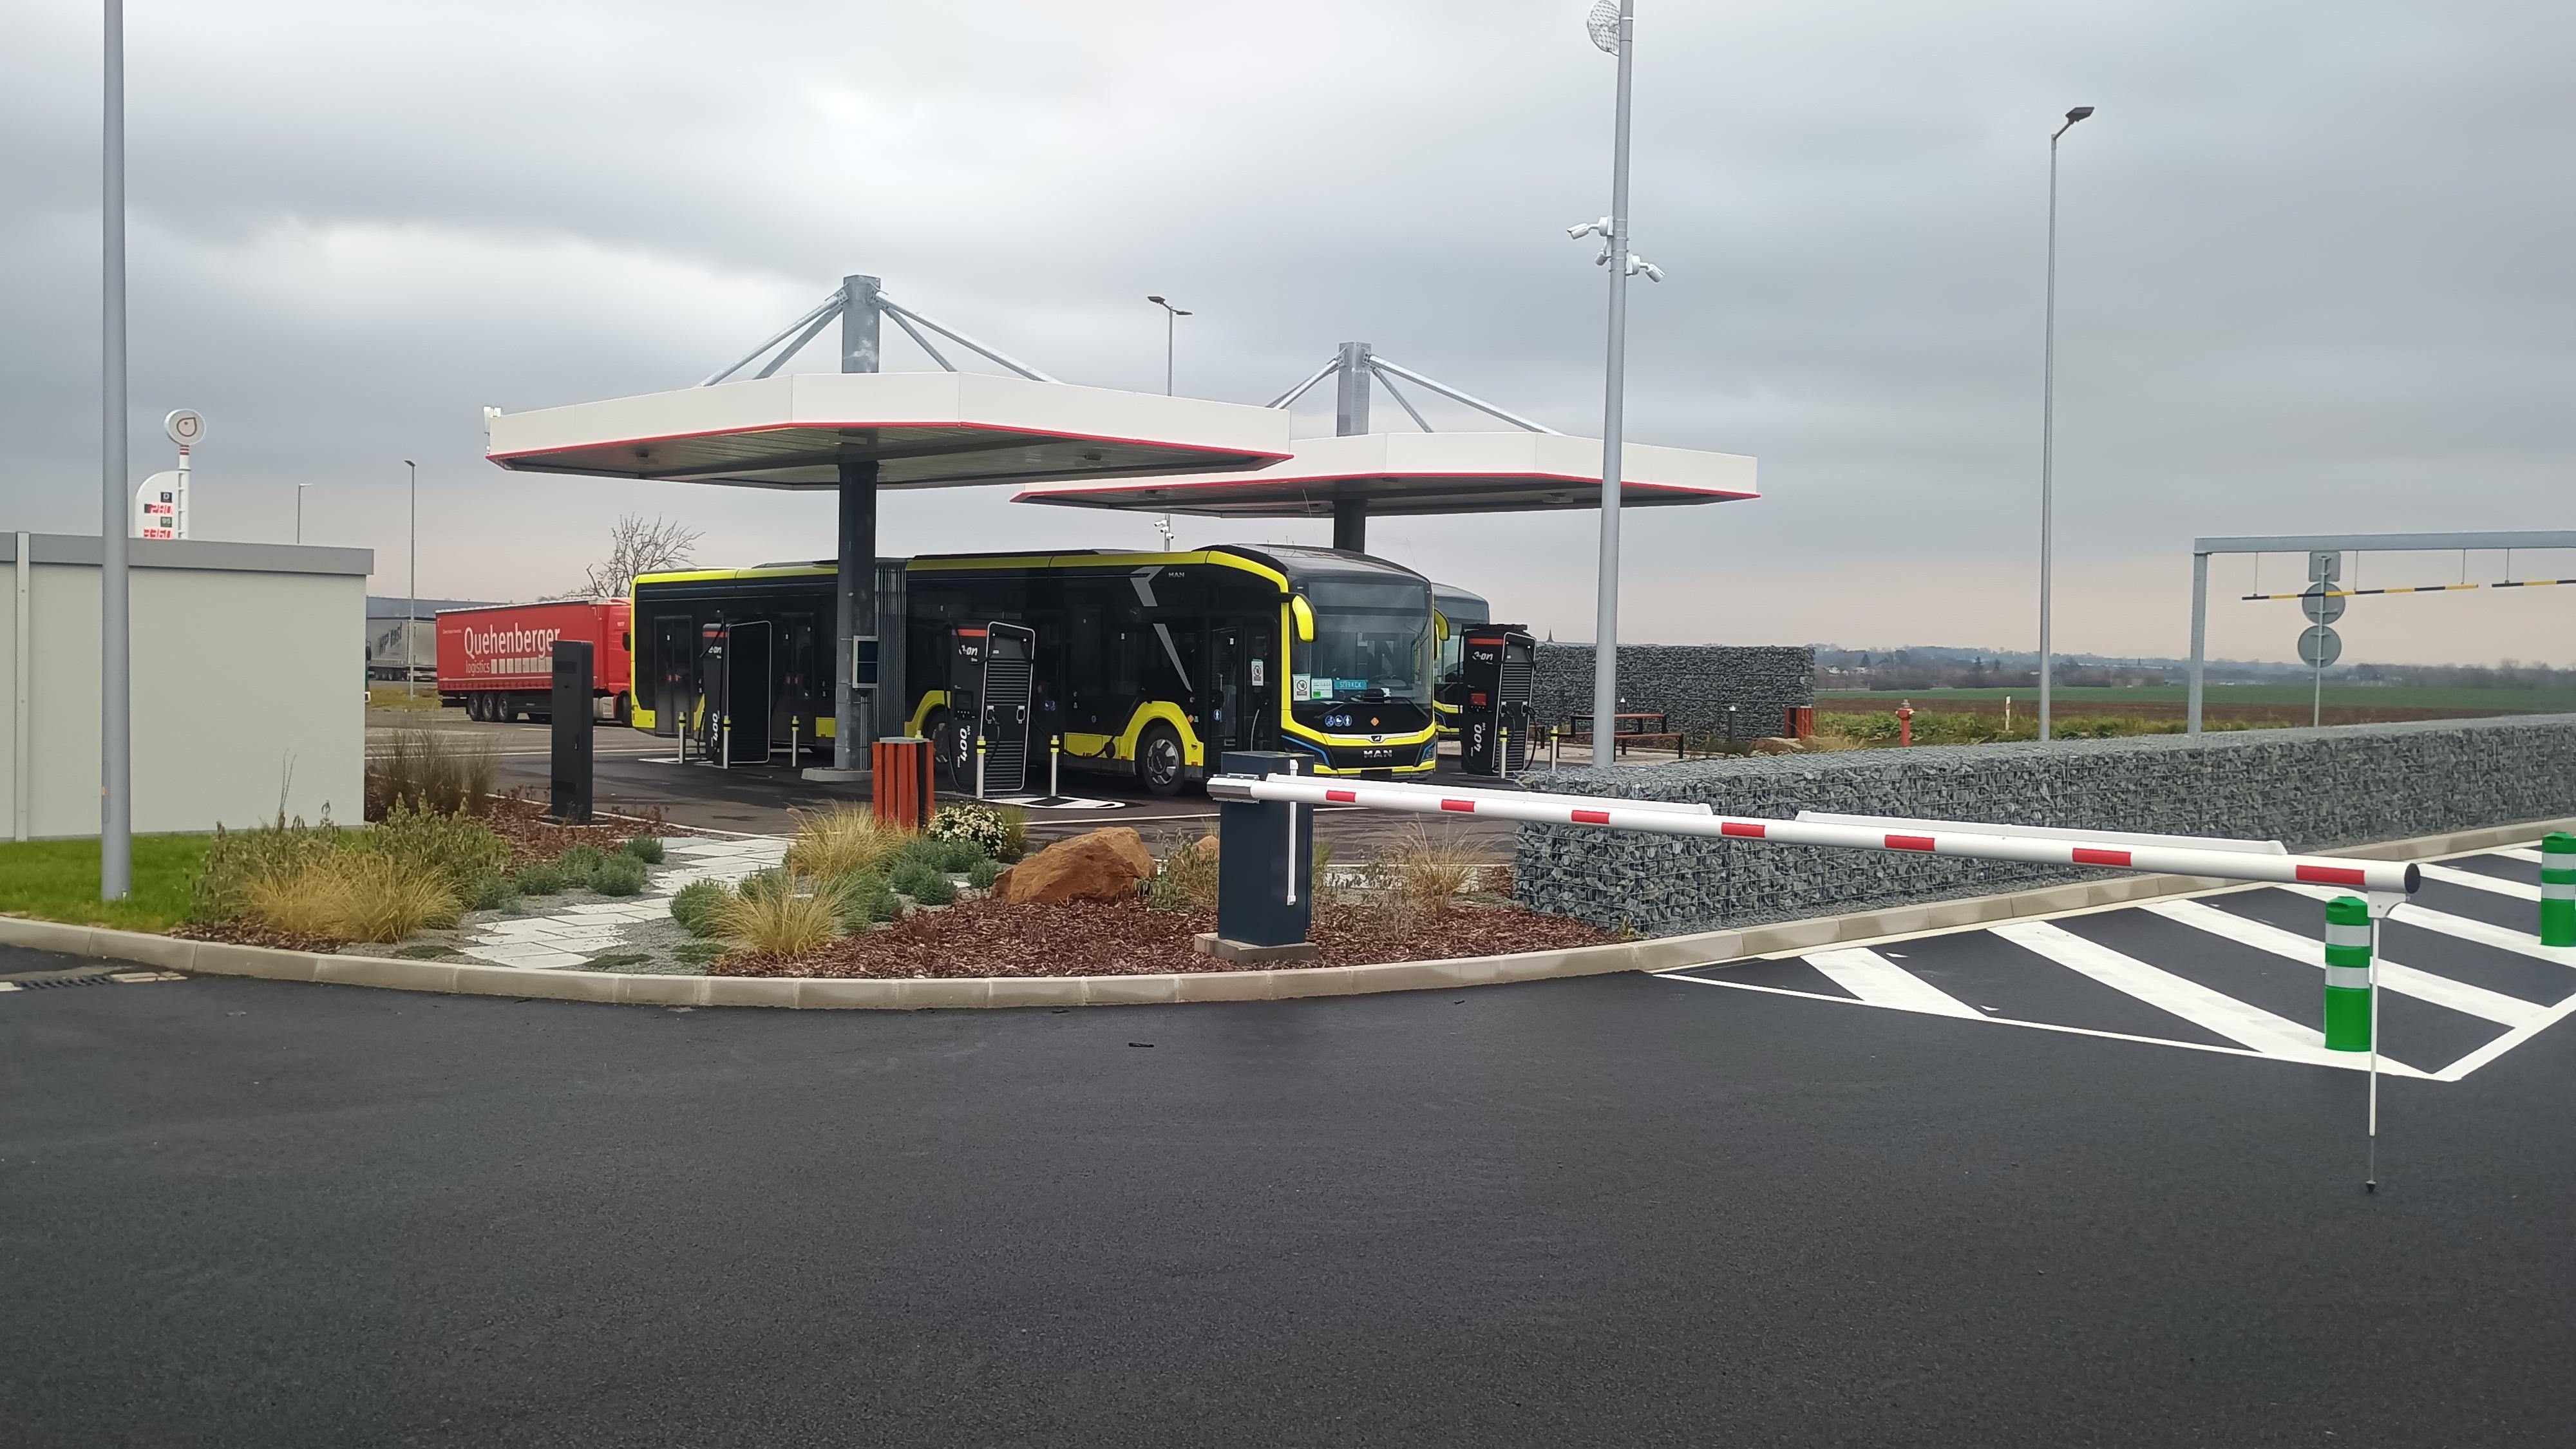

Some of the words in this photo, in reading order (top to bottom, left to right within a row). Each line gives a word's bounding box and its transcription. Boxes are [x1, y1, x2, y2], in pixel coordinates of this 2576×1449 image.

[464, 622, 561, 659] Quehenberger
[466, 659, 490, 676] logistics
[1473, 724, 1482, 752] 400
[1363, 750, 1392, 758] MAN
